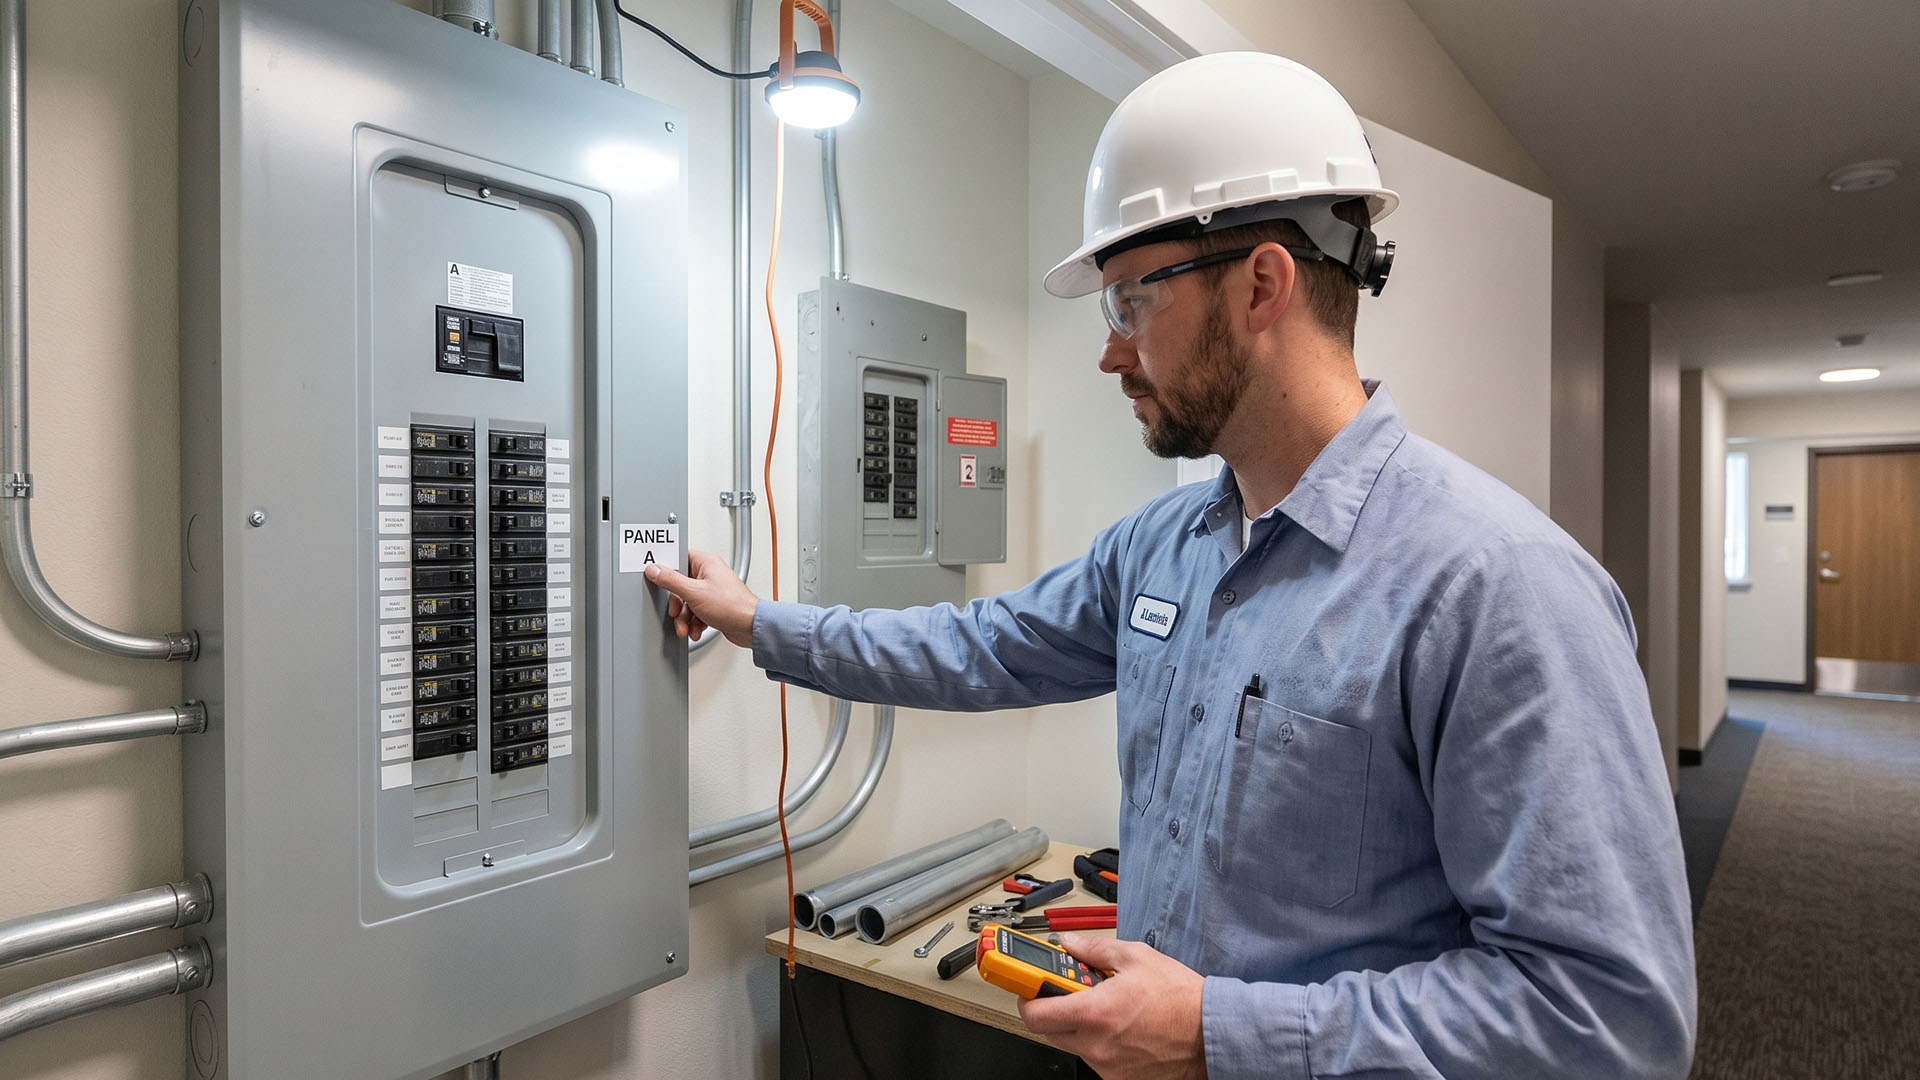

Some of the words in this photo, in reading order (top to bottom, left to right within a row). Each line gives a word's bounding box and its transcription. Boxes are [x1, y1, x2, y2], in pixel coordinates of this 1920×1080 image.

[450, 263, 459, 275] A
[965, 464, 973, 480] 2
[624, 529, 675, 544] PANEL
[643, 551, 655, 564] A
